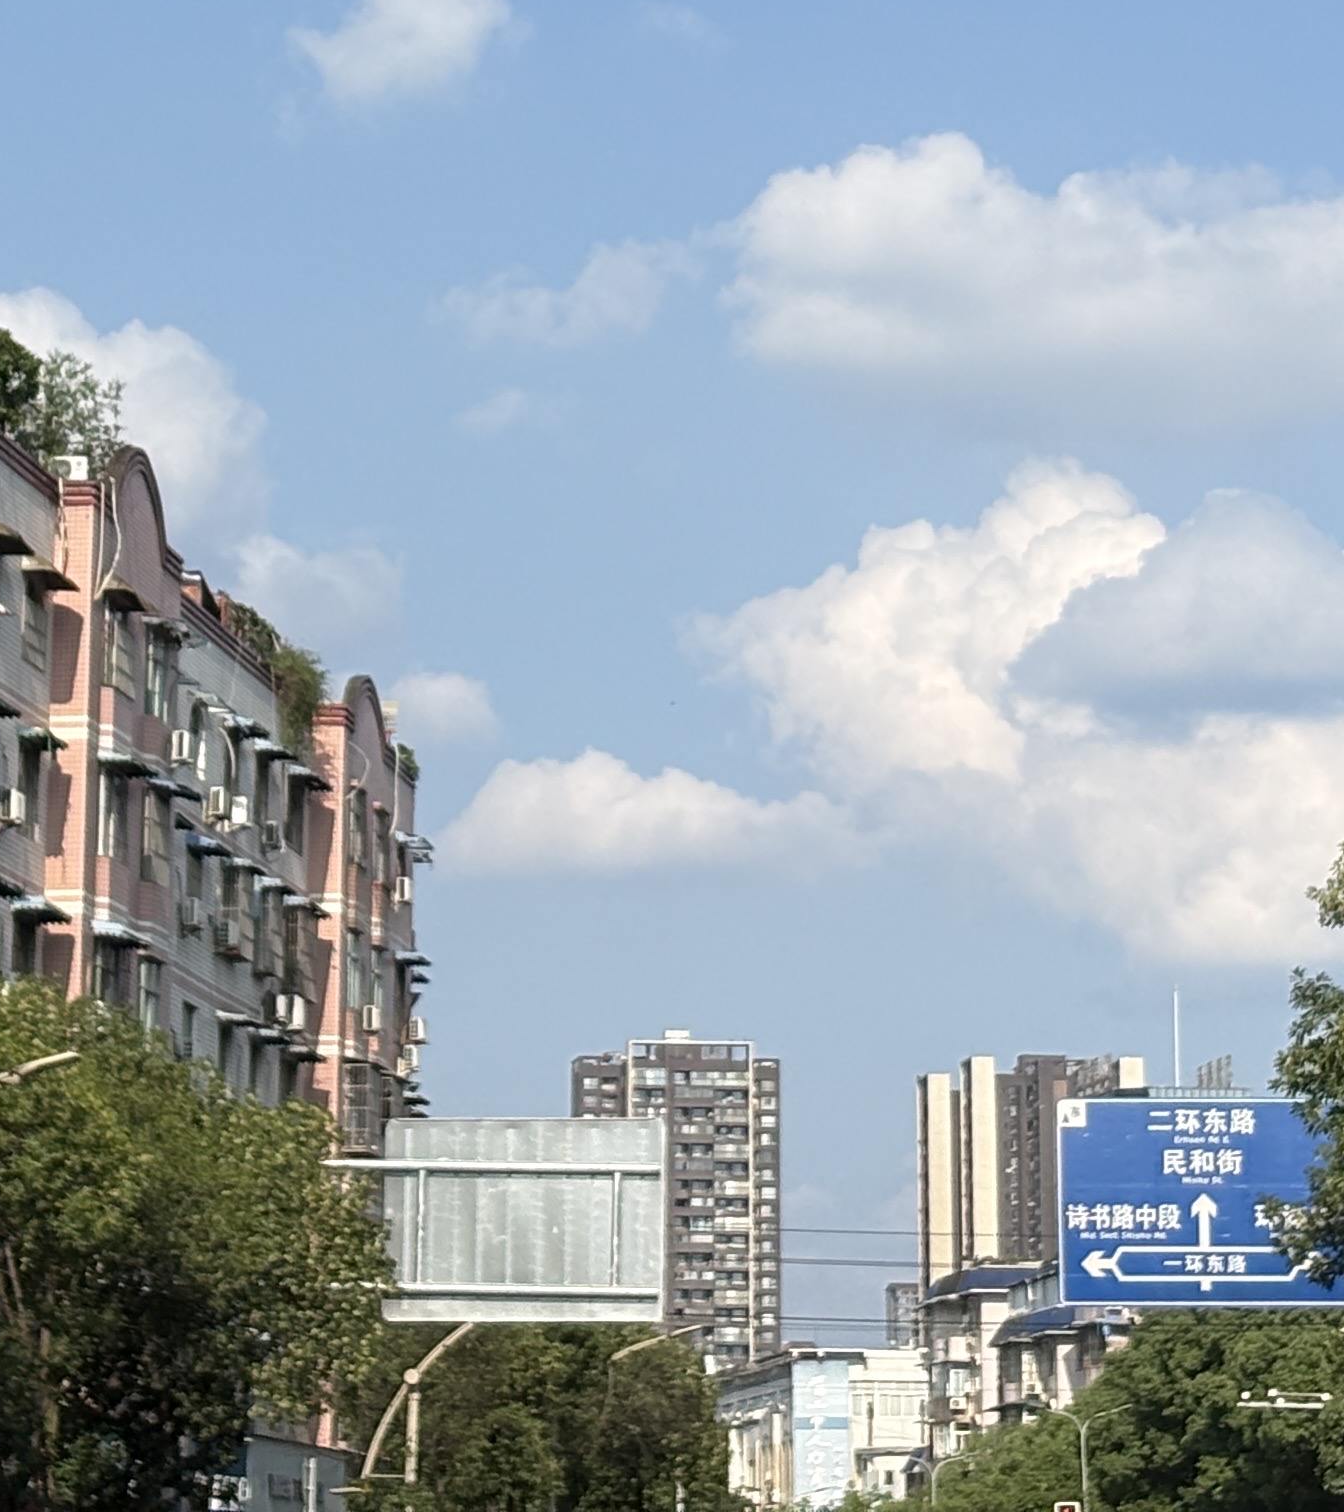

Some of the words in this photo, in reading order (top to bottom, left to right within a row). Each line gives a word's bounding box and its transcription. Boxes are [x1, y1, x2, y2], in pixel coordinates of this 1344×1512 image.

[1147, 1108, 1256, 1135] 二环东路
[1163, 1148, 1243, 1175] 民和街
[1065, 1203, 1182, 1230] 诗书路中段
[1163, 1254, 1247, 1273] 一环东路
